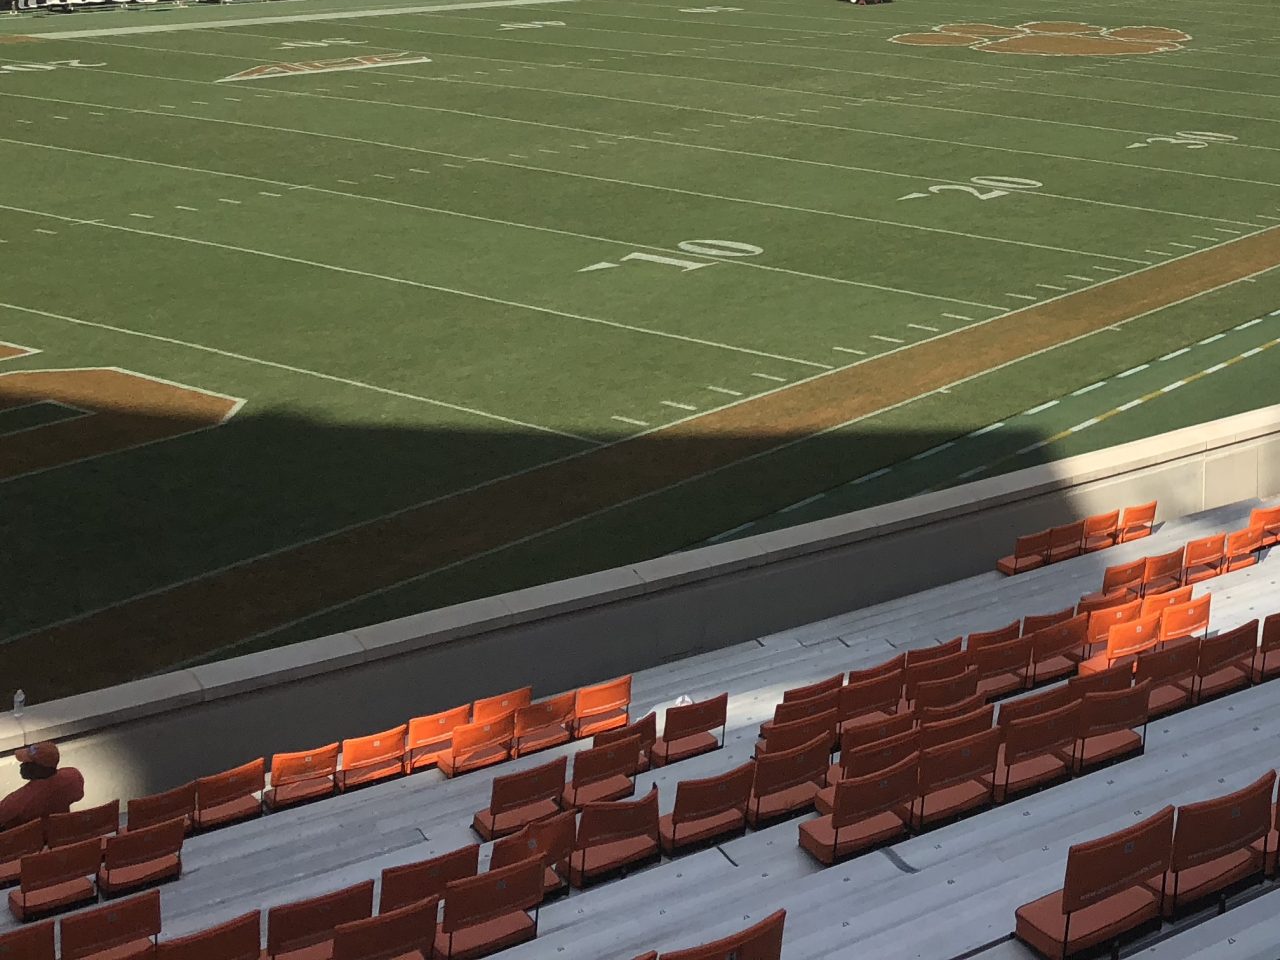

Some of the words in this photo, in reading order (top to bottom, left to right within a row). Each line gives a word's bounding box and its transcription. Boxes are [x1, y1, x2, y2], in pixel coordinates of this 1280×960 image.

[1146, 131, 1239, 148] 30
[928, 176, 1043, 200] 20
[619, 239, 764, 272] 10
